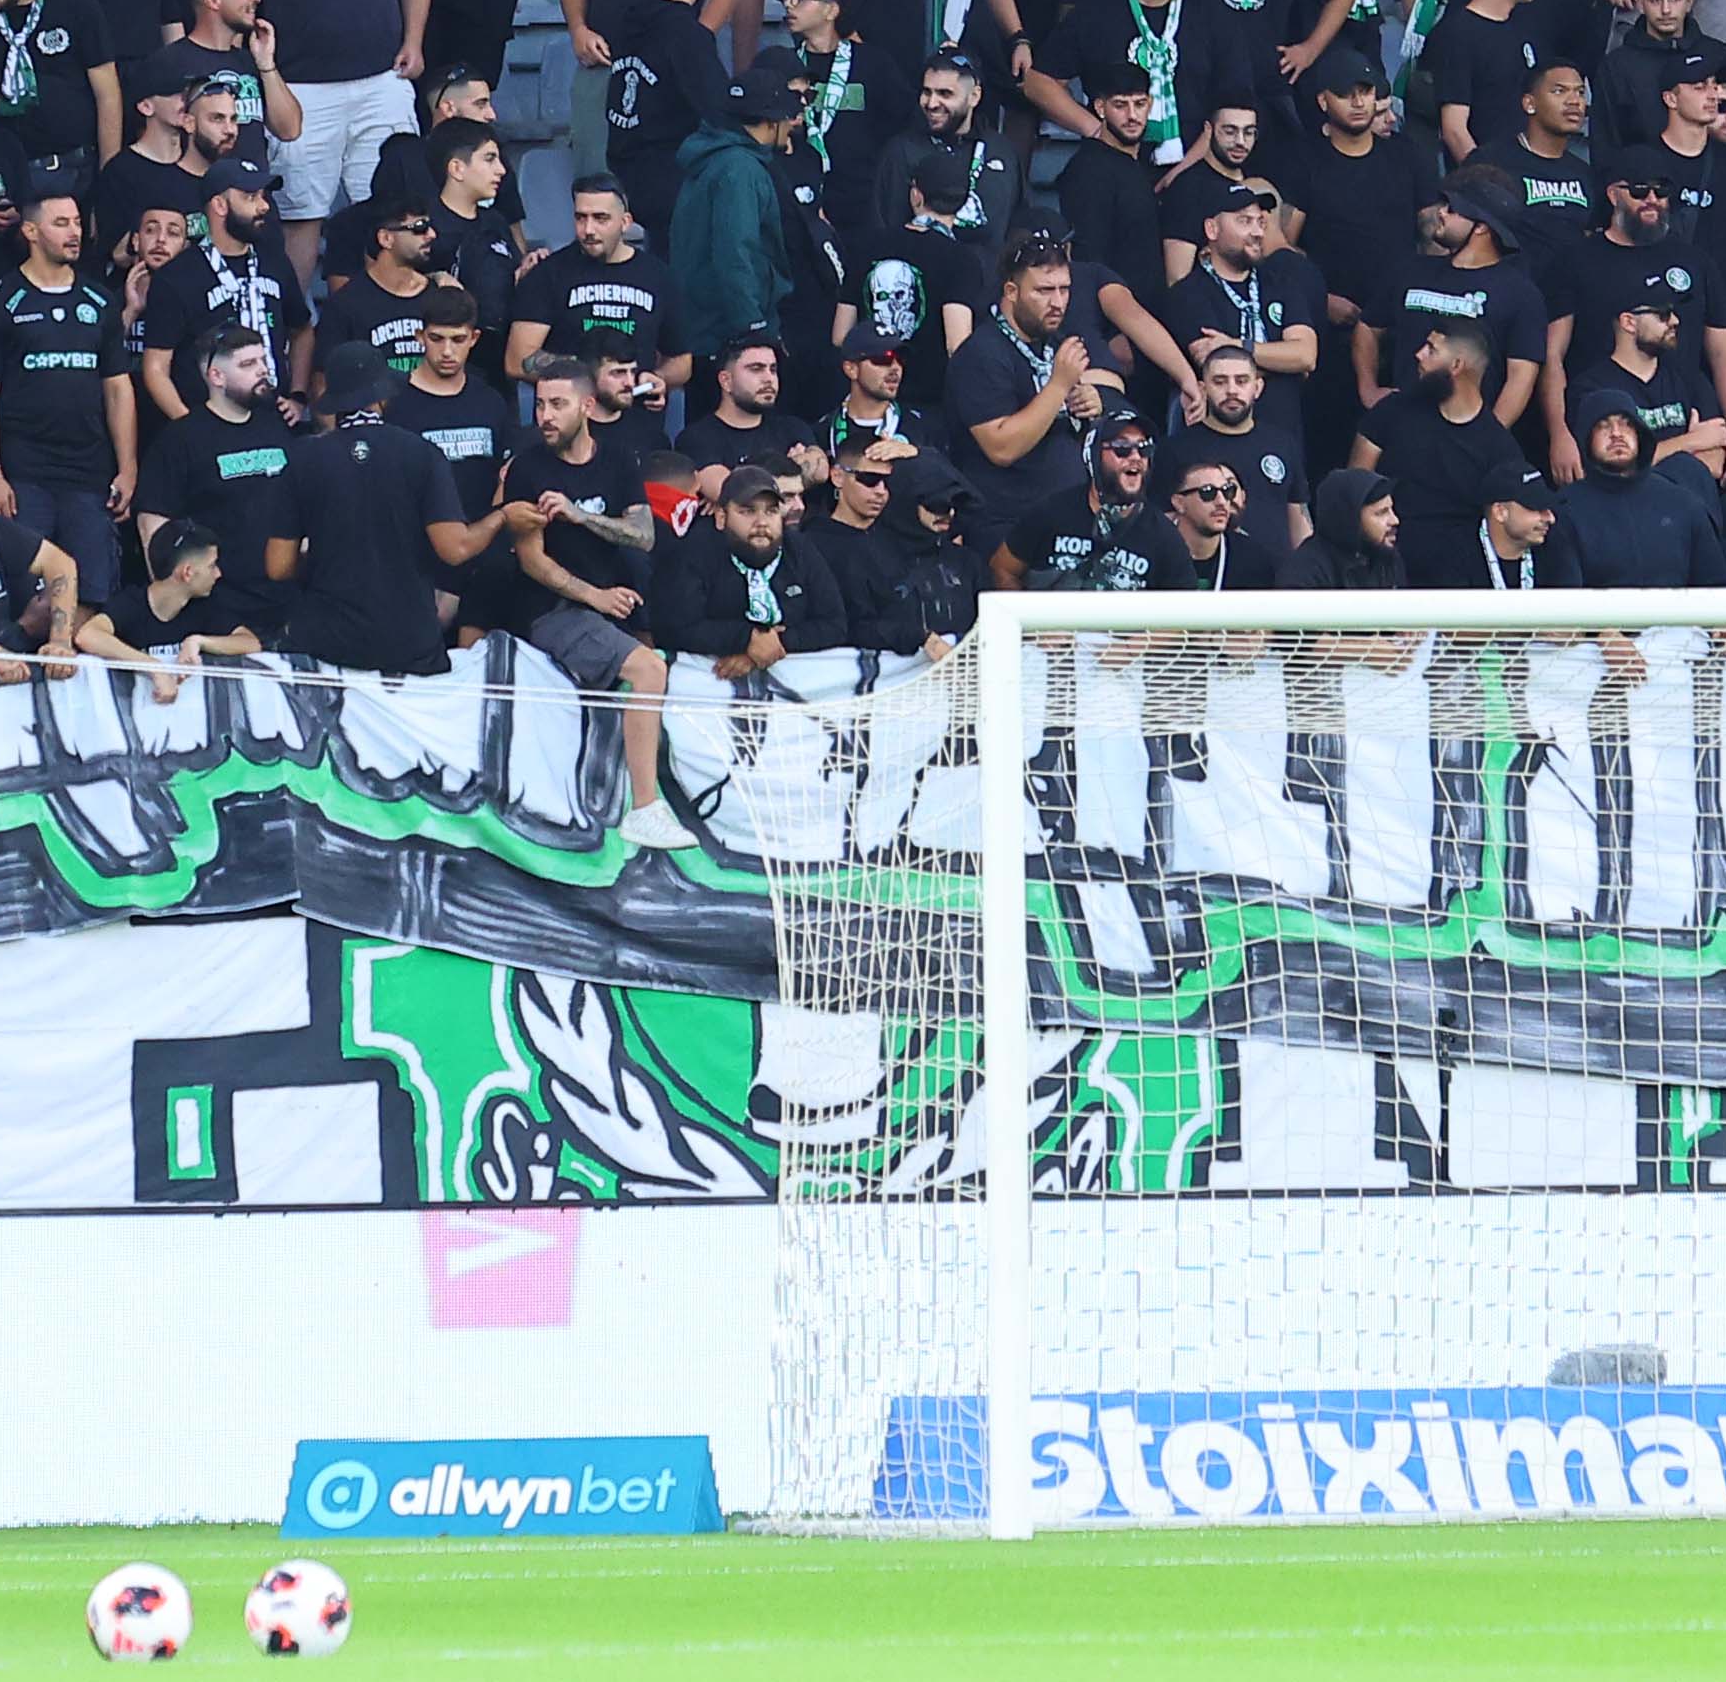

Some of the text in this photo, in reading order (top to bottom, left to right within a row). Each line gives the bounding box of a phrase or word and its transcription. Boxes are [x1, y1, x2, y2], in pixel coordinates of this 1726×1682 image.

[1523, 177, 1587, 208] LARNACA
[568, 284, 653, 312] ARCHERMOU
[591, 304, 630, 319] STREET
[388, 1464, 571, 1529] allwyn
[576, 1463, 677, 1515] bet
